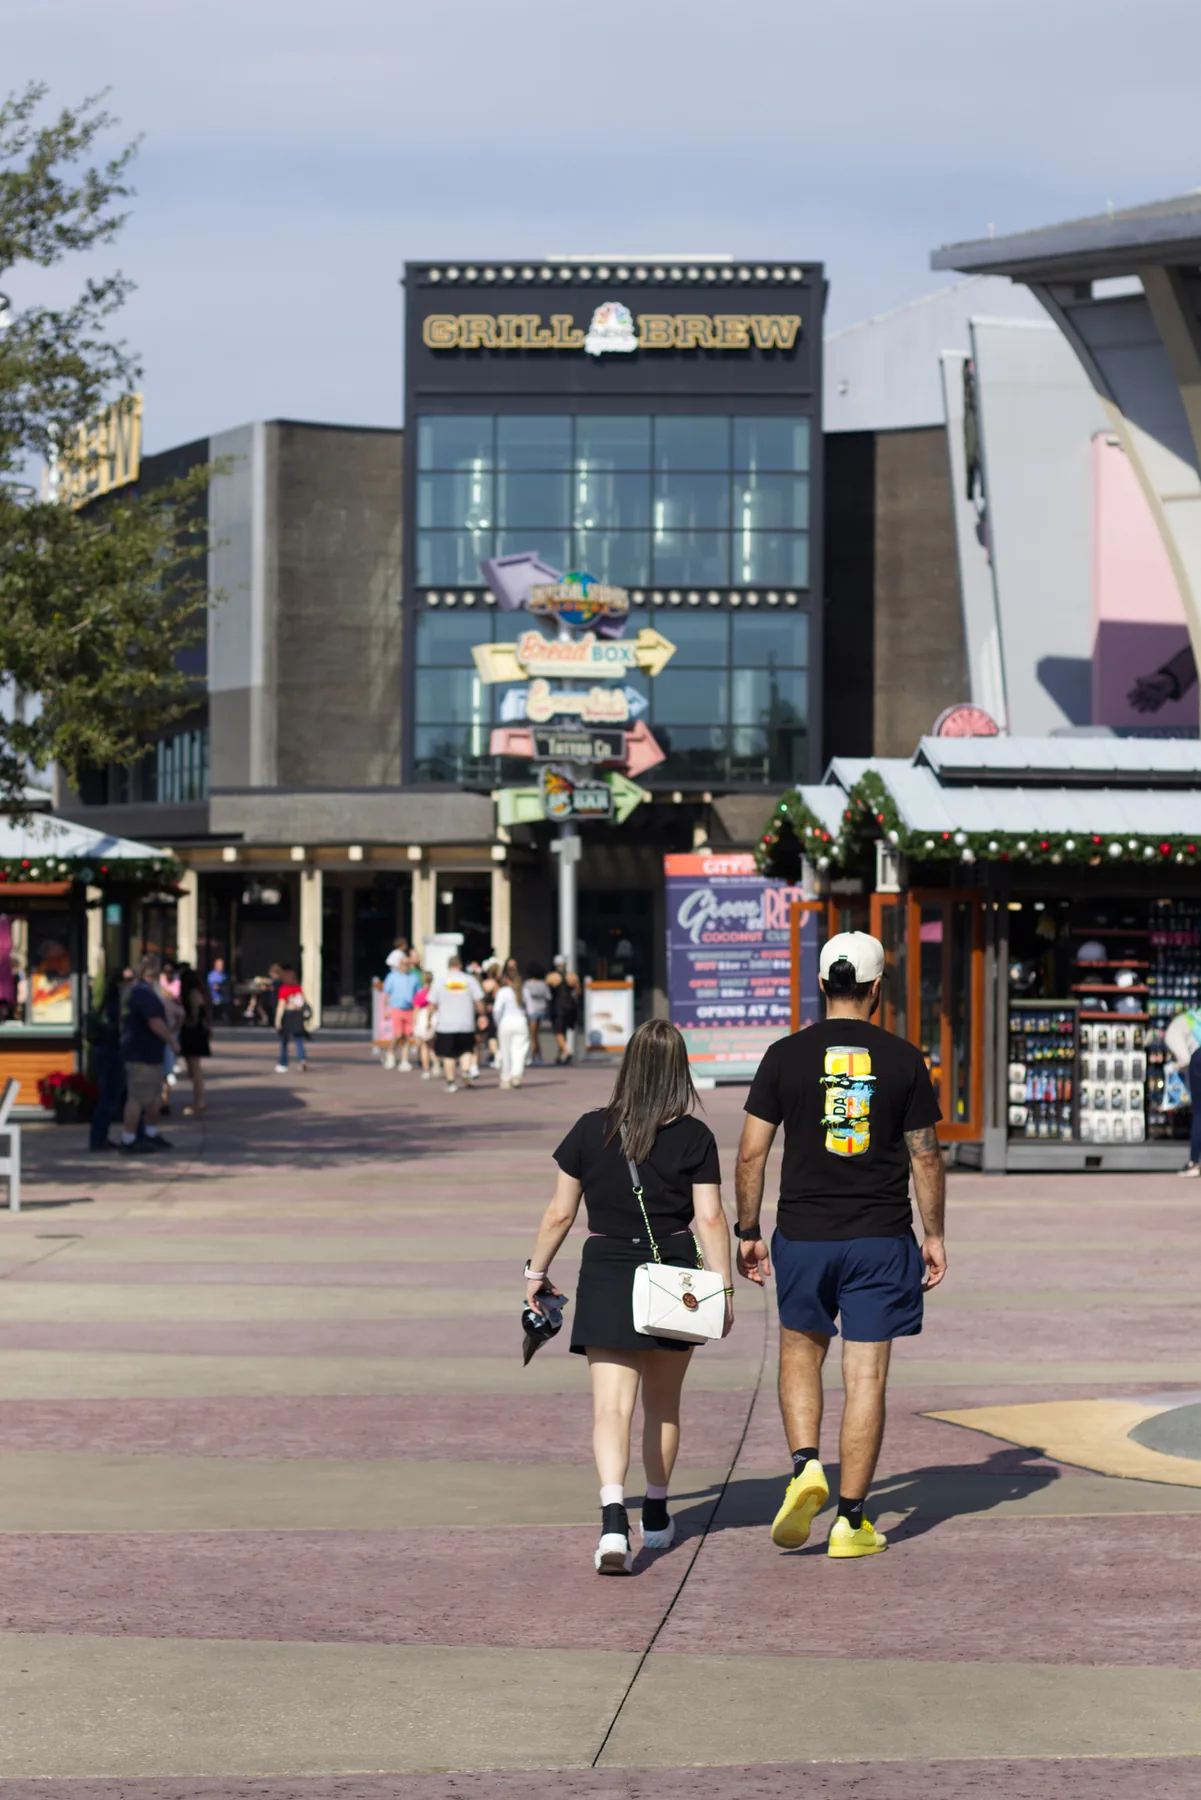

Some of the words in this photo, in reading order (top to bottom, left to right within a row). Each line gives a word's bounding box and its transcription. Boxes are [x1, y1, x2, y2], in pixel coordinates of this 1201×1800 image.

[423, 313, 584, 348] GRILL
[637, 313, 801, 349] BREW
[592, 646, 631, 662] BOX
[701, 931, 764, 943] COCONUT
